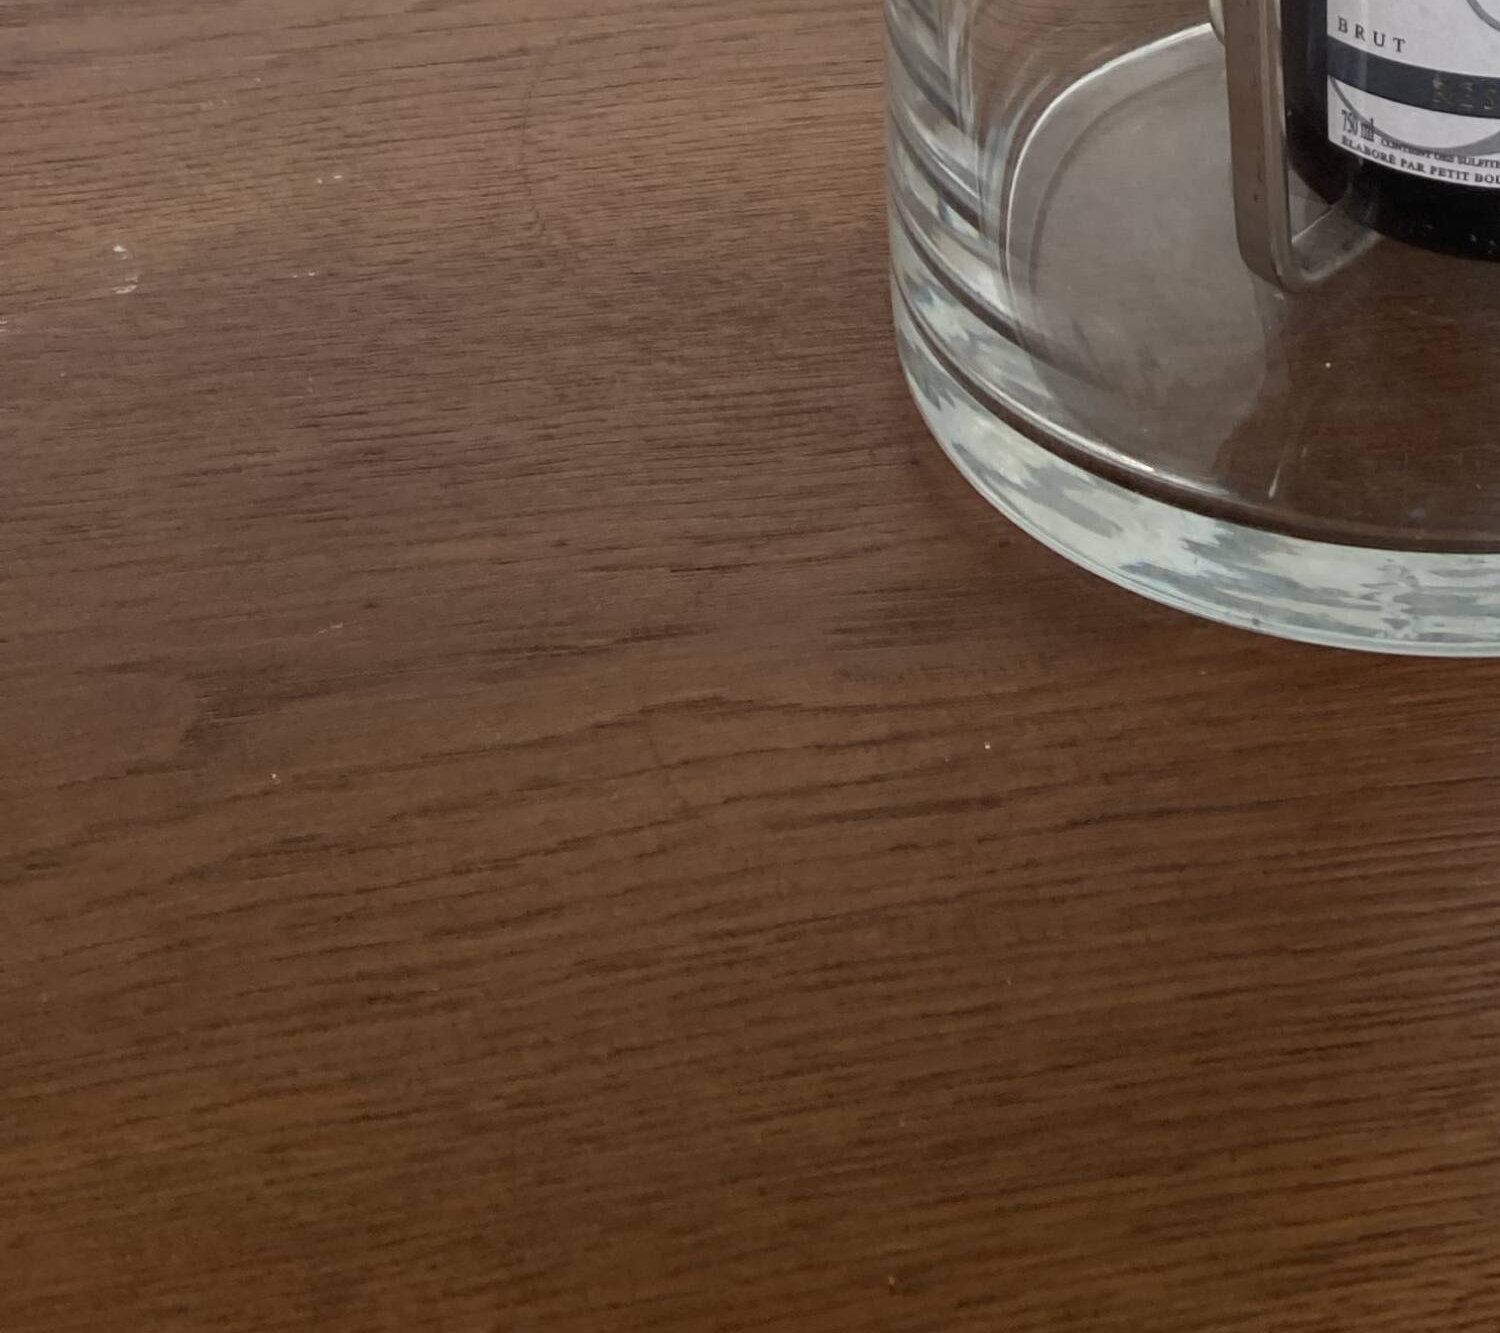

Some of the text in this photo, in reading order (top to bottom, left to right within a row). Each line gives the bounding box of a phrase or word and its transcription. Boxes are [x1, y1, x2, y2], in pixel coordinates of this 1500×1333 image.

[1337, 16, 1406, 53] BRUT
[1341, 109, 1359, 136] 750
[1400, 158, 1425, 174] PAR
[1430, 165, 1470, 181] PETIT
